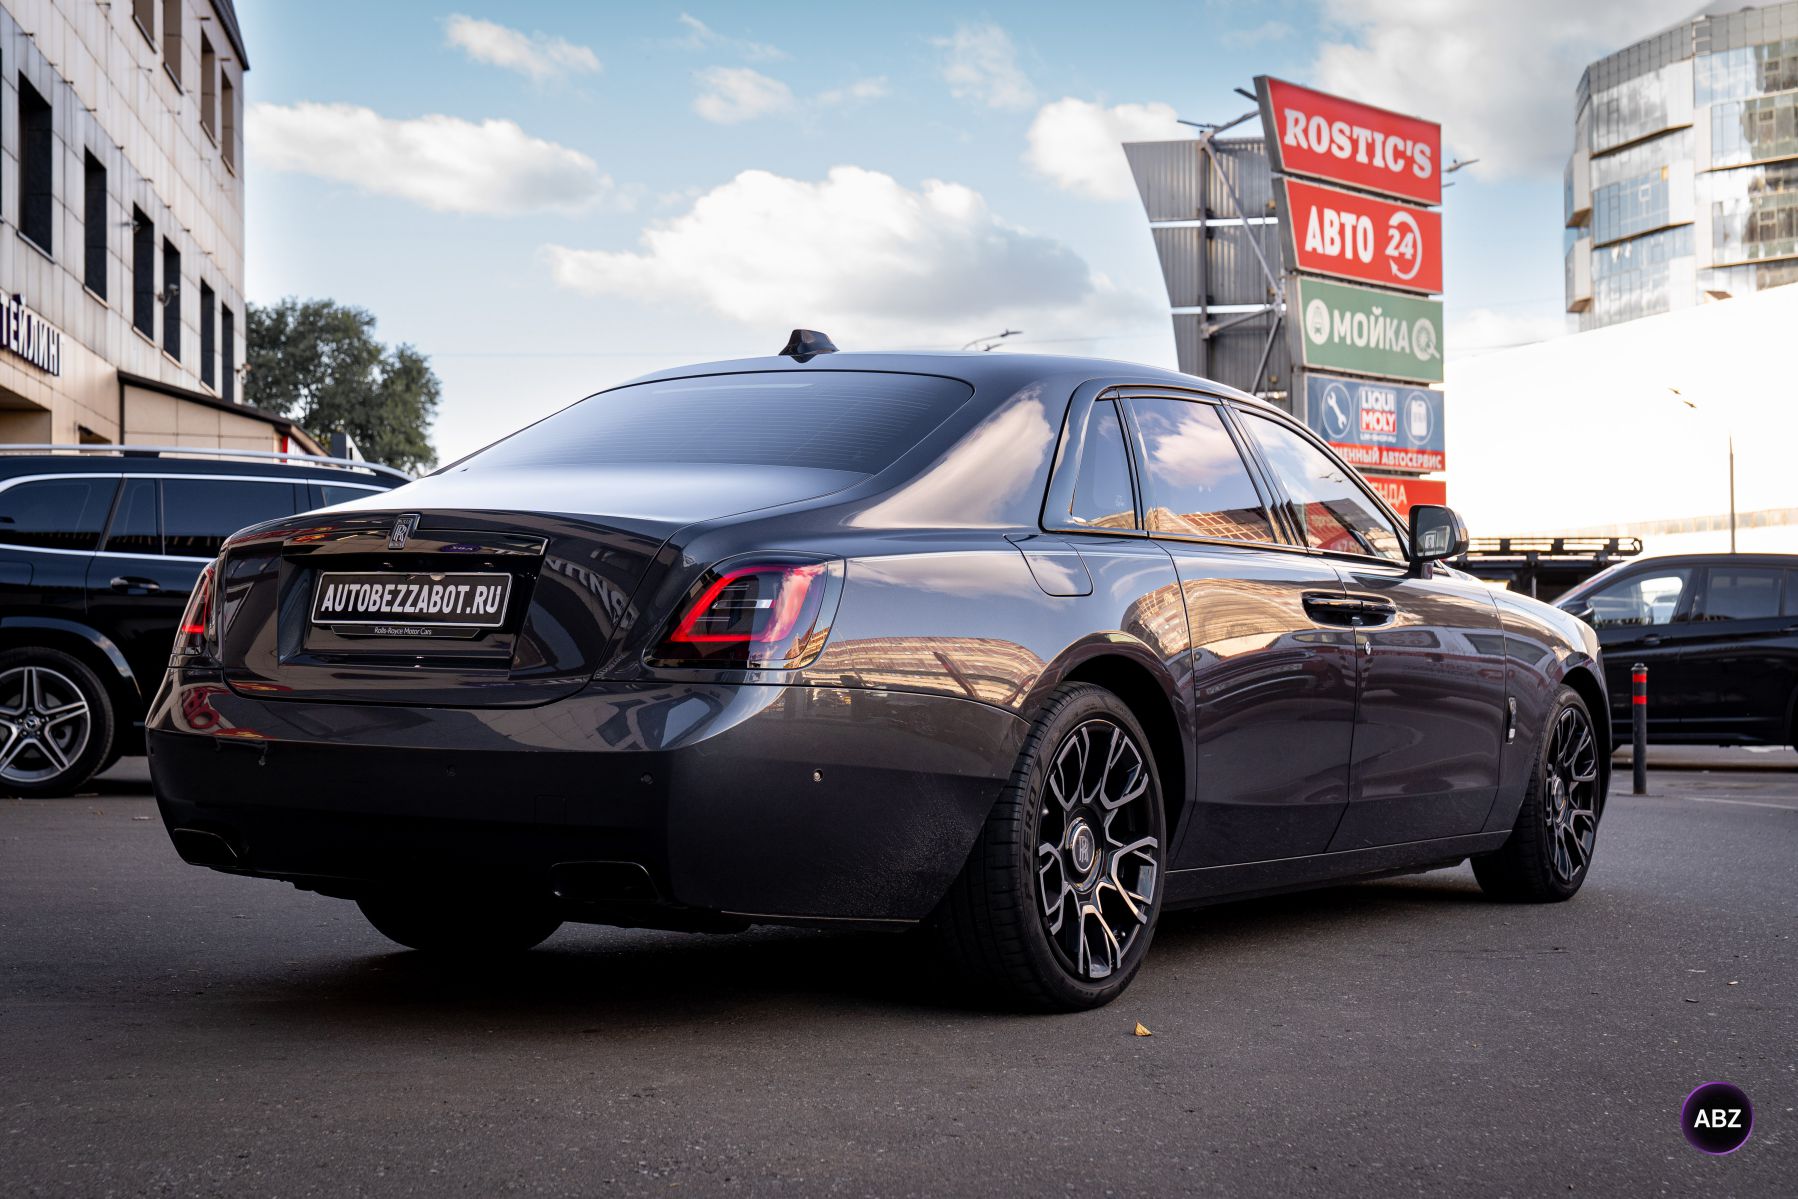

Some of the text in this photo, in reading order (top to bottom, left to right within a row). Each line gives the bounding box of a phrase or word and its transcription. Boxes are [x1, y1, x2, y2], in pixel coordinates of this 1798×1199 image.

[1284, 108, 1432, 179] ROSTIC'S
[1305, 205, 1414, 264] АВТО 24
[1333, 306, 1410, 354] МОЙКА
[1361, 389, 1395, 411] LIQUI
[1361, 409, 1396, 432] MOLY
[1381, 450, 1442, 469] АВТОСЕРВИС
[321, 584, 502, 615] AUTOBEZZABOT.RU
[374, 626, 432, 636] Rolls-Royce Motor Cars
